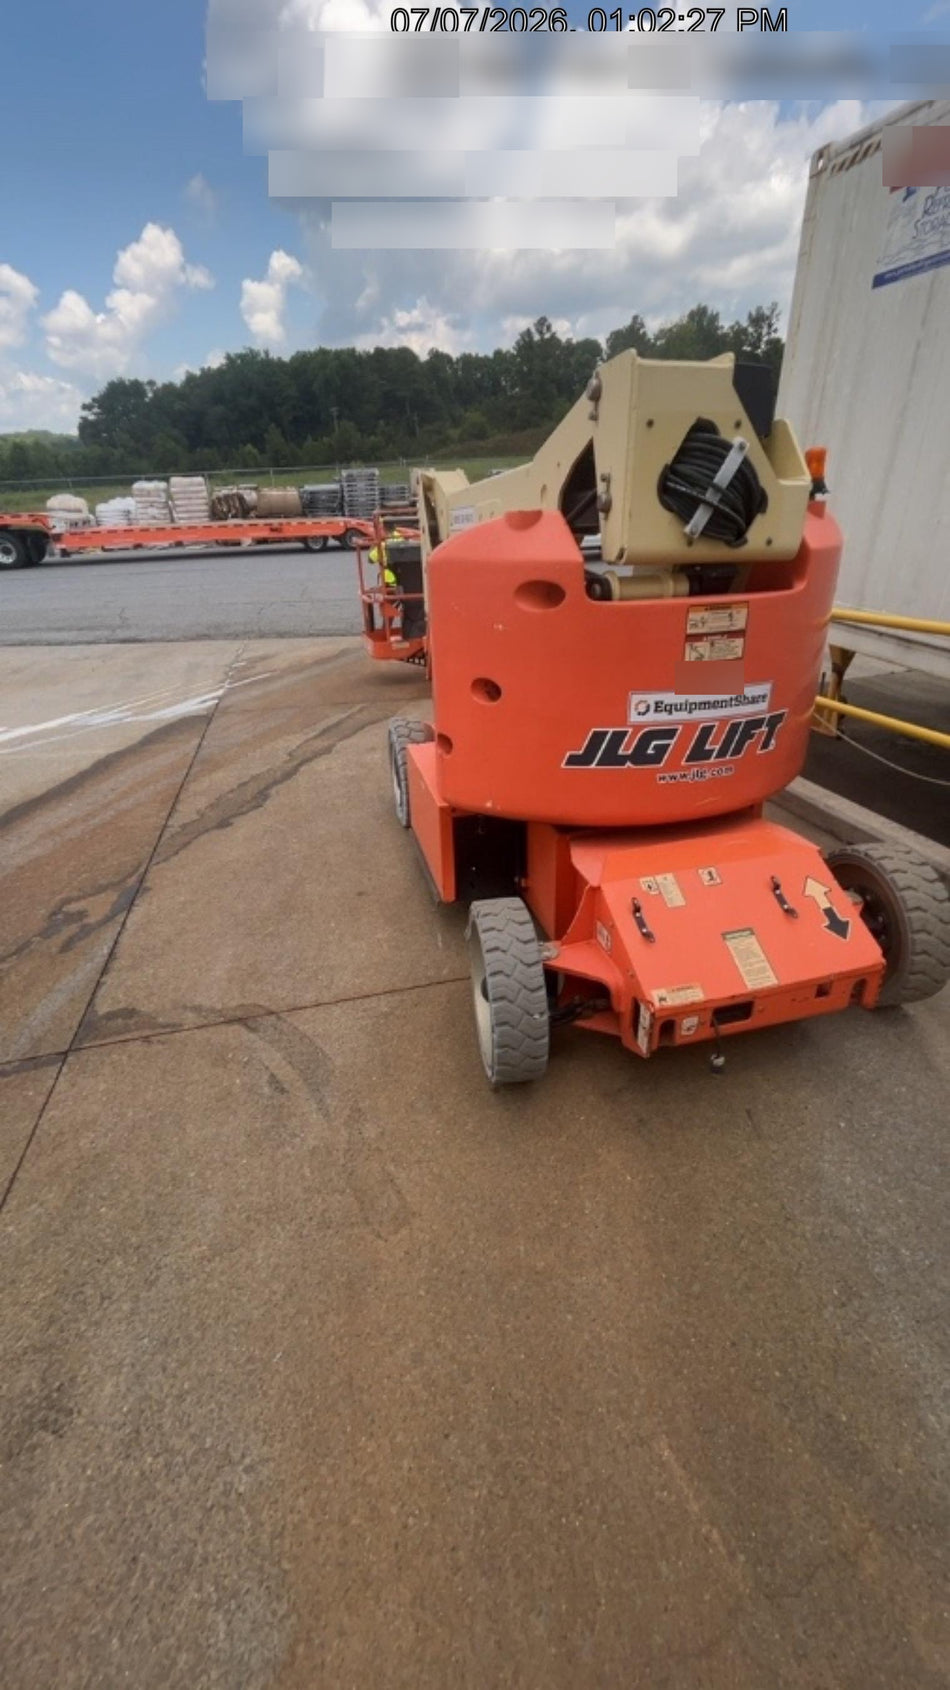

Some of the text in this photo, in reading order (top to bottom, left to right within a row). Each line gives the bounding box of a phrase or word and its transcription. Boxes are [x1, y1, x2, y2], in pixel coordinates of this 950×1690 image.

[653, 692, 768, 715] EquipmentShare
[563, 709, 788, 768] JLG LIFT
[657, 765, 734, 784] www.jlg.com
